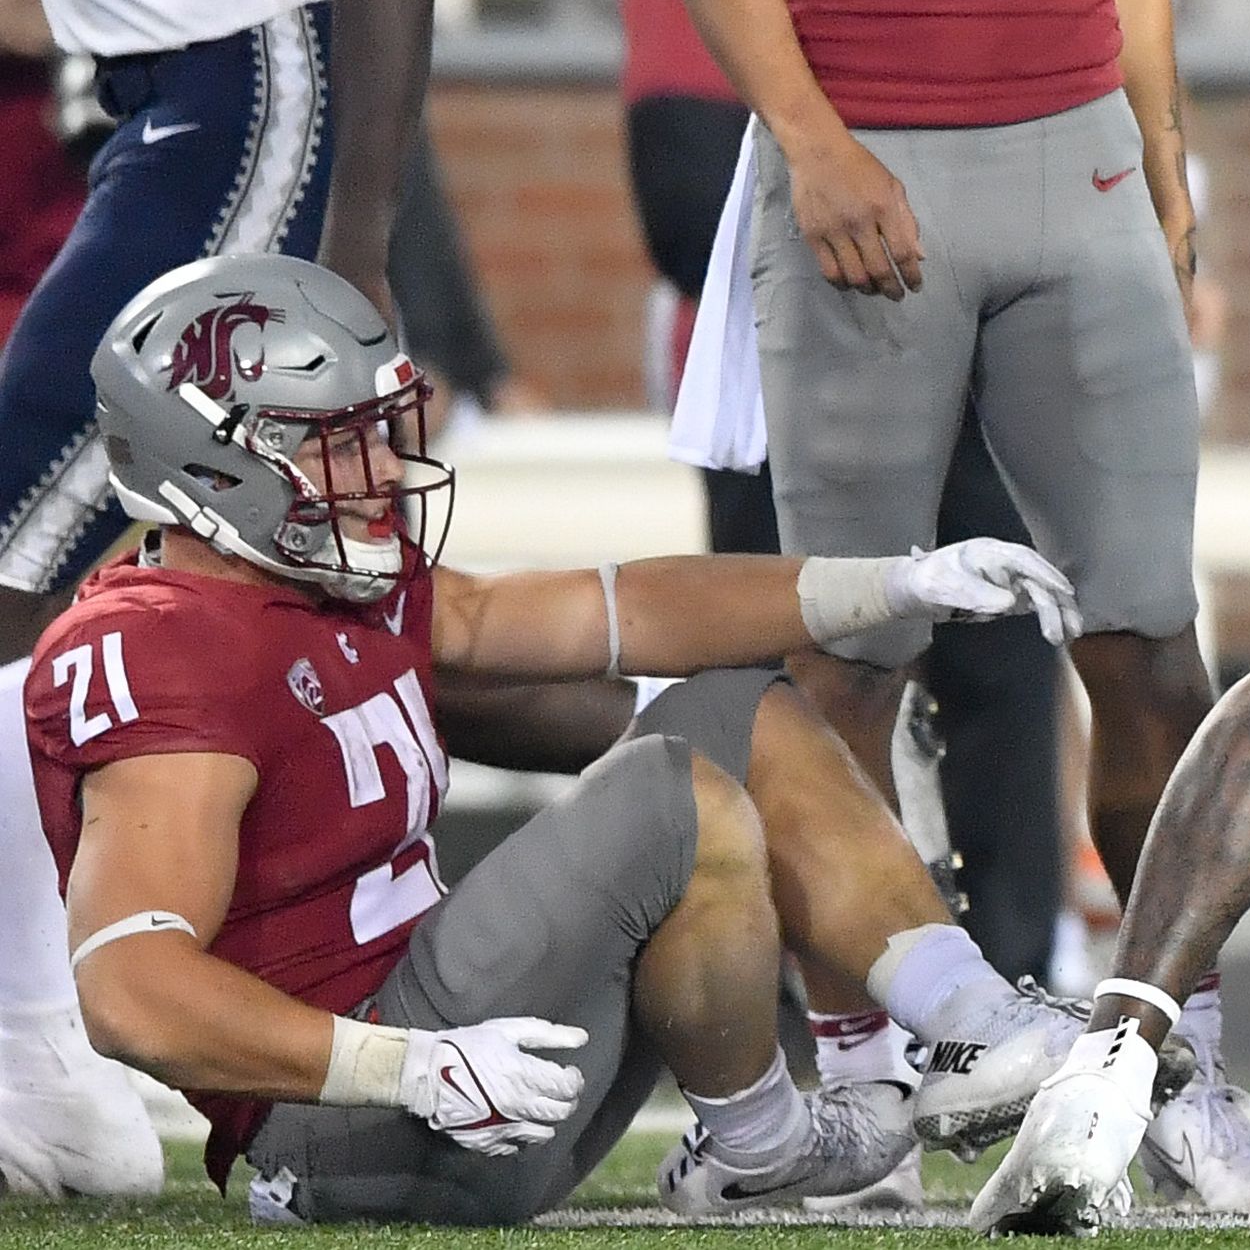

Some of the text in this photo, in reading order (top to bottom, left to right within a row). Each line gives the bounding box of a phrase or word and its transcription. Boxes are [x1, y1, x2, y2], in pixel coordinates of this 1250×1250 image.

[52, 630, 140, 748] 21
[319, 666, 451, 947] 21
[926, 1041, 988, 1075] NIKE
